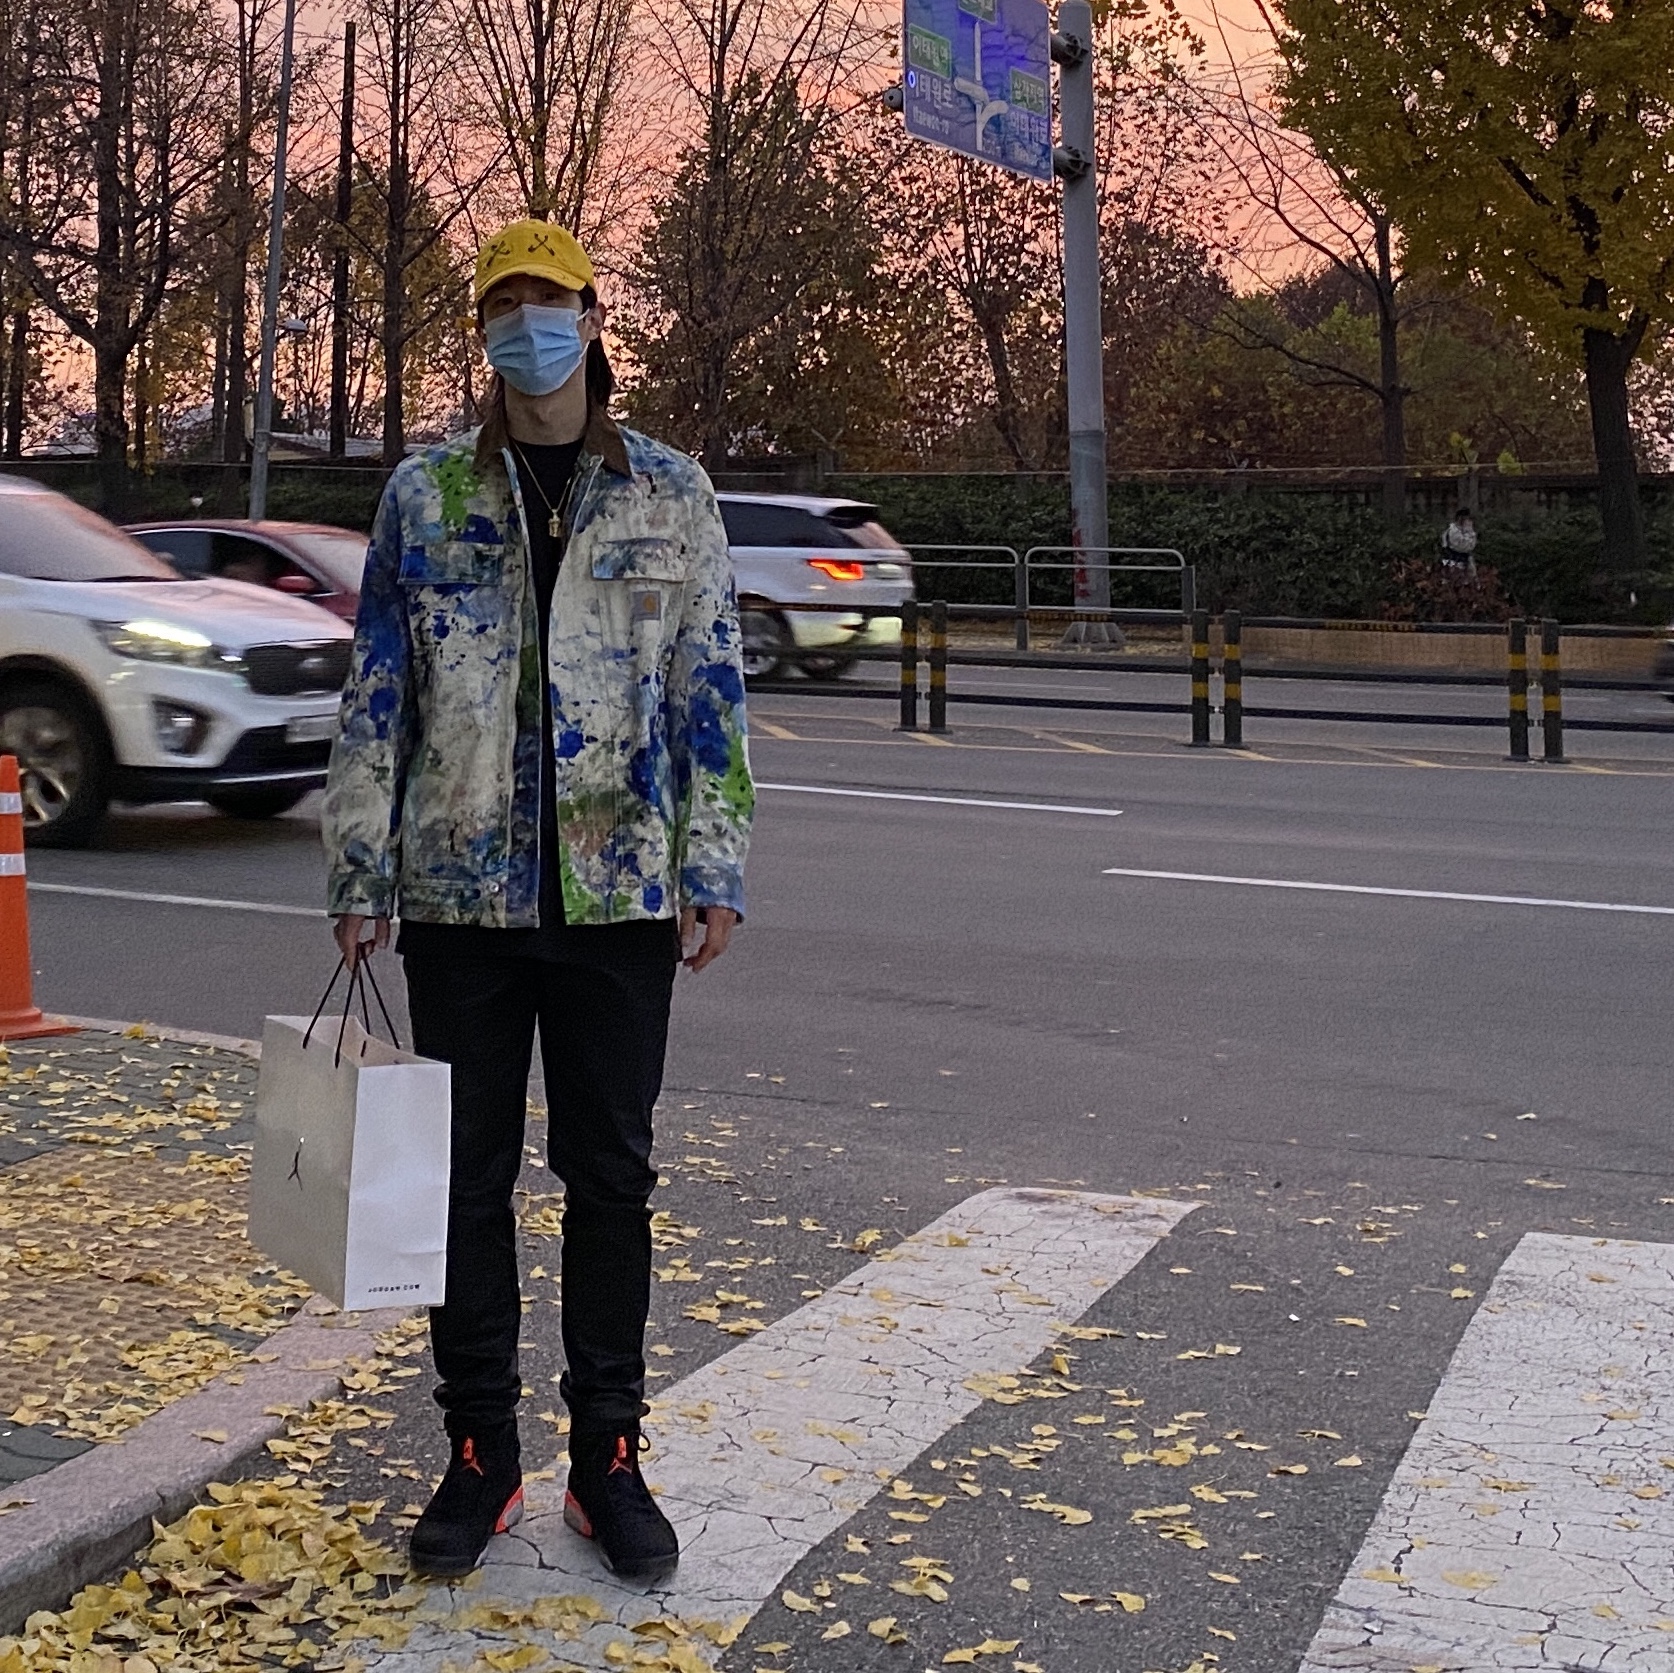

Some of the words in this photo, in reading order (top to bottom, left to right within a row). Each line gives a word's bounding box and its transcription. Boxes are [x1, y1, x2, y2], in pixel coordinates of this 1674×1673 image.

[912, 35, 948, 69] 이태원역
[908, 70, 954, 111] 이태원로
[1013, 78, 1045, 112] 삼각지역
